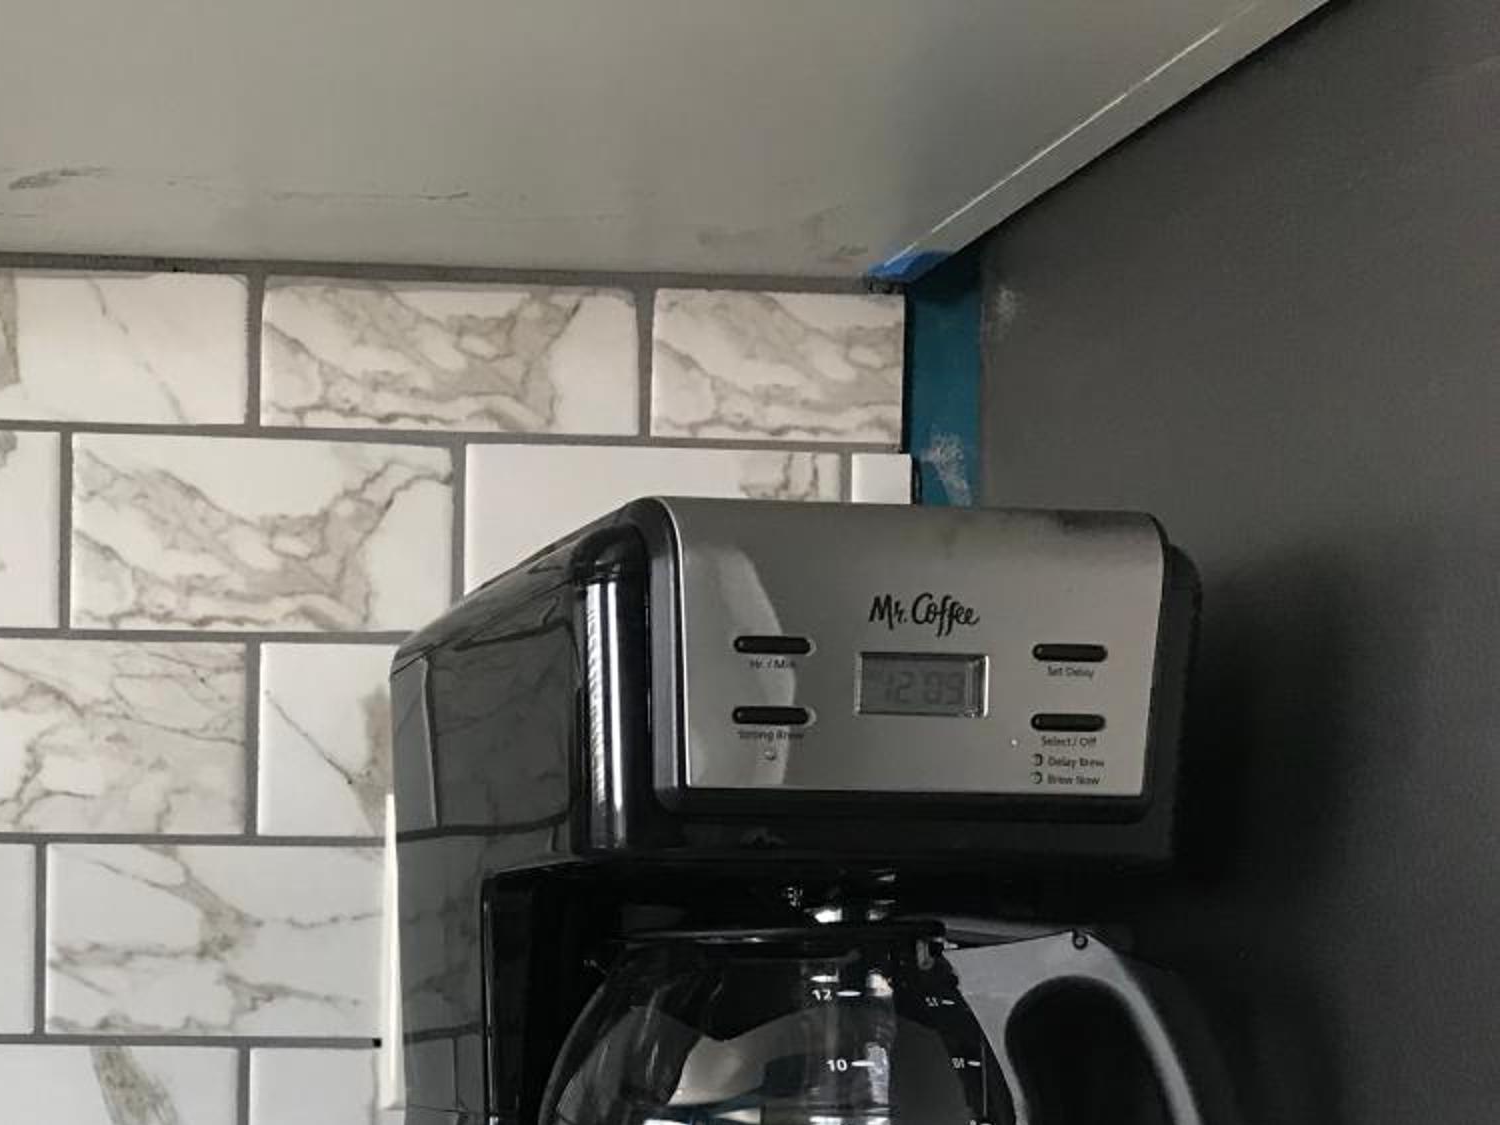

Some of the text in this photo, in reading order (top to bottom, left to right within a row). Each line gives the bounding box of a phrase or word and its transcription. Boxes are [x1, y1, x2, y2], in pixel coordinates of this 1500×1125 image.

[868, 592, 980, 637] Mr. Coffee
[1048, 755, 1076, 768] Delay
[812, 989, 833, 1001] 12
[826, 1058, 848, 1072] 10
